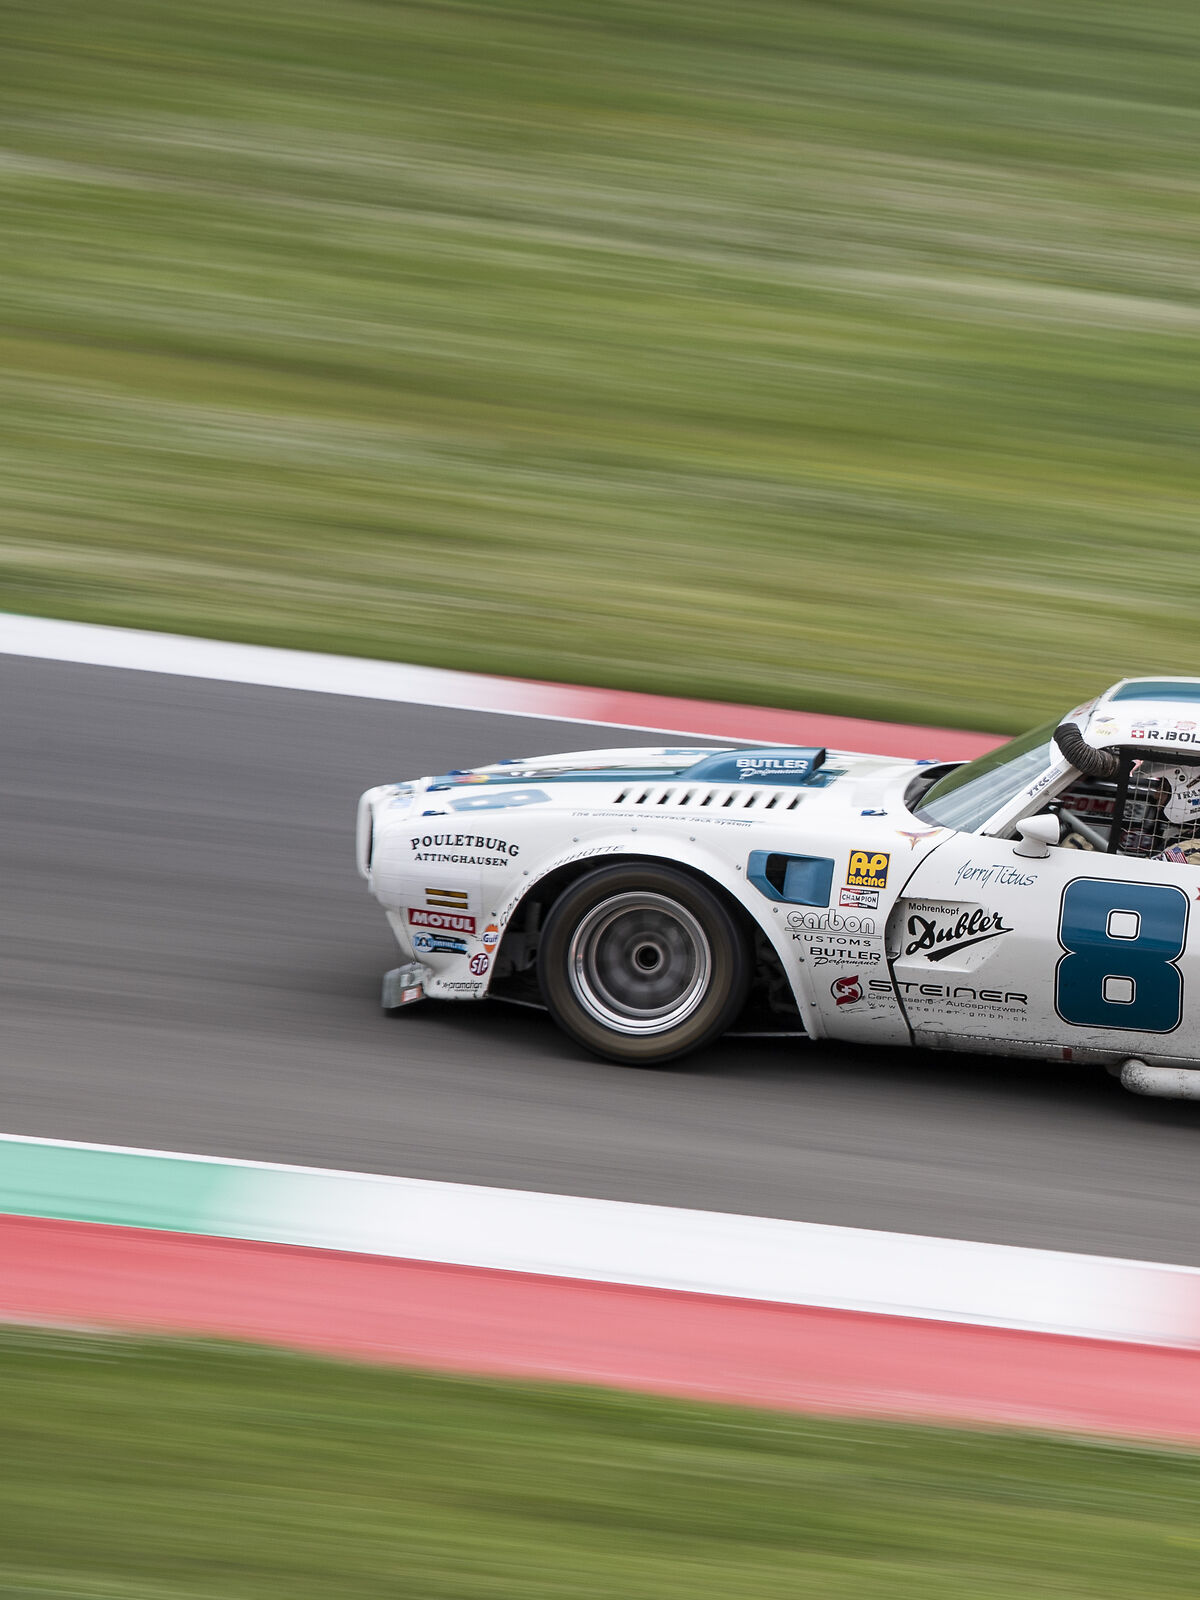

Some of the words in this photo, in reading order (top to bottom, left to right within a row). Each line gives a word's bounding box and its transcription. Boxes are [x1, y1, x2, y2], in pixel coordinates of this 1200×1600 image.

[736, 759, 809, 769] BUTLER
[1027, 776, 1050, 797] YTCC
[411, 834, 520, 857] POULETBURG
[414, 853, 509, 867] ATTINGHAUSEN
[850, 852, 888, 877] AP
[848, 876, 886, 887] RACING
[954, 859, 994, 888] Jerry
[992, 865, 1038, 886] Titus
[842, 894, 877, 903] CHAMPION
[909, 902, 960, 916] Mohrenkopf
[411, 911, 474, 931] MOTUL
[787, 909, 875, 934] carbon
[482, 933, 499, 943] Gulf
[792, 934, 871, 947] KUSTOMS
[905, 908, 1014, 956] Dubler
[810, 947, 881, 961] BUTLER
[813, 956, 879, 967] Performance
[1054, 875, 1191, 1034] 8
[471, 954, 488, 974] STP
[868, 979, 1028, 1005] STEINER
[946, 1001, 1027, 1014] Autospritzwerk
